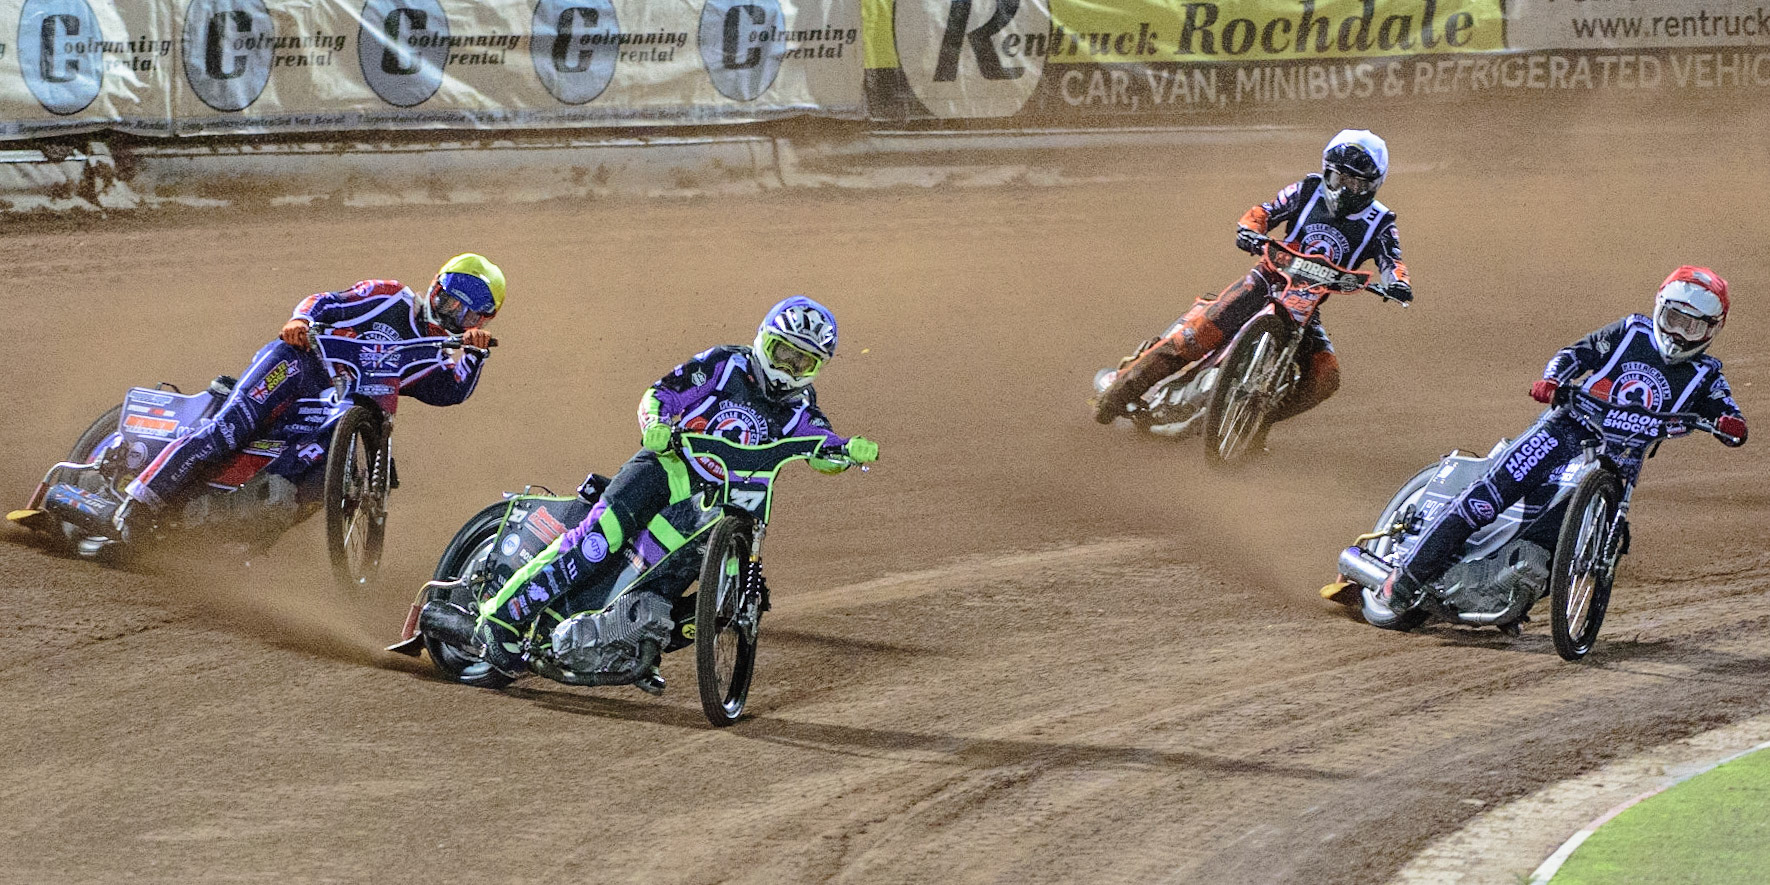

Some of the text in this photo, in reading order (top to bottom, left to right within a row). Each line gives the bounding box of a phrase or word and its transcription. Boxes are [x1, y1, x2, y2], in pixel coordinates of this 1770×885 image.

[1174, 0, 1474, 56] Rochdale
[273, 51, 333, 68] rental
[448, 48, 506, 65] rental
[619, 46, 675, 63] rental
[784, 42, 843, 60] rental
[1235, 62, 1376, 101] MINIBUS
[1382, 62, 1404, 96] &
[1413, 55, 1661, 95] REFRIGERATED
[1291, 257, 1340, 283] BORGE
[1620, 374, 1660, 406] BELLE VUE ACES
[1622, 361, 1672, 400] PETER CRAVEN
[716, 411, 738, 423] BELLE
[741, 413, 753, 427] VUE
[1603, 418, 1659, 437] SHOCKS
[1606, 409, 1663, 427] HAGON
[1505, 429, 1550, 474] HAGON
[1513, 437, 1559, 482] SHOCKS
